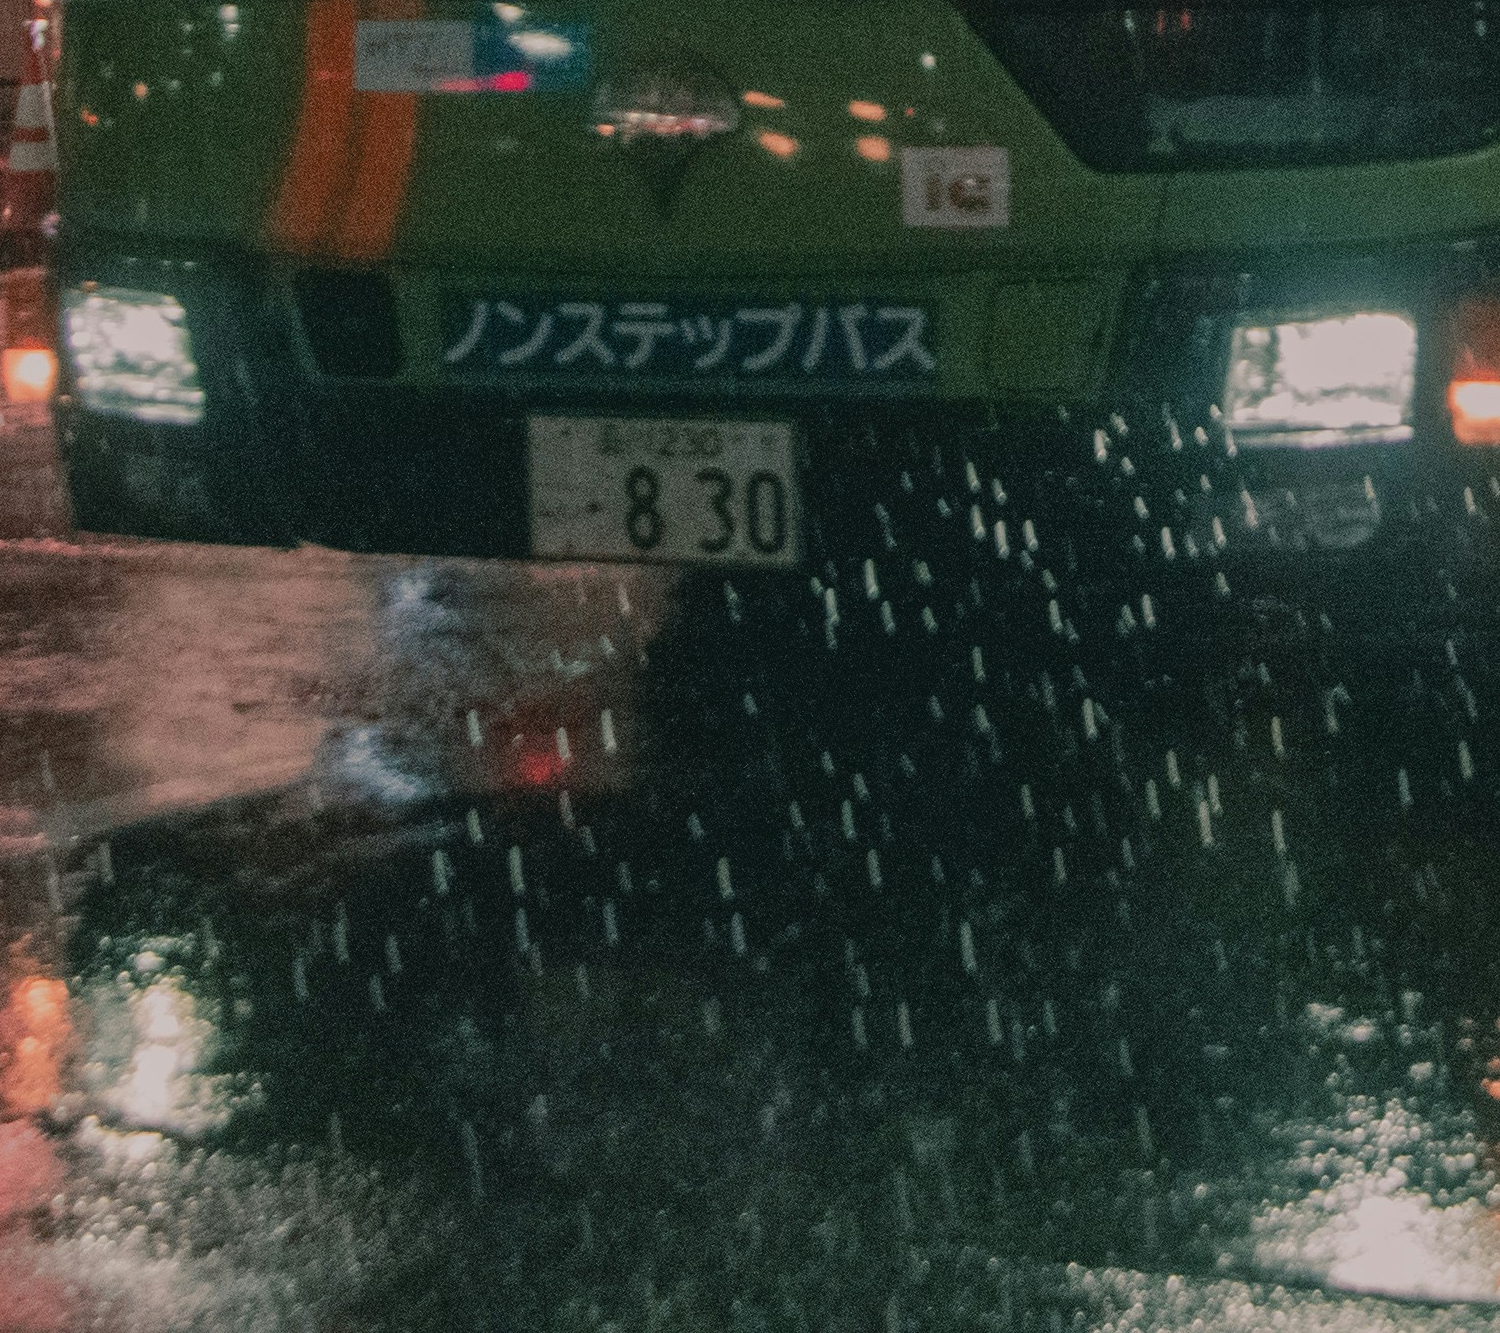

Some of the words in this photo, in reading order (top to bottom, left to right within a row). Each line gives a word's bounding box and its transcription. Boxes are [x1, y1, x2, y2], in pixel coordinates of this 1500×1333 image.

[444, 301, 936, 373] ノンステップバス
